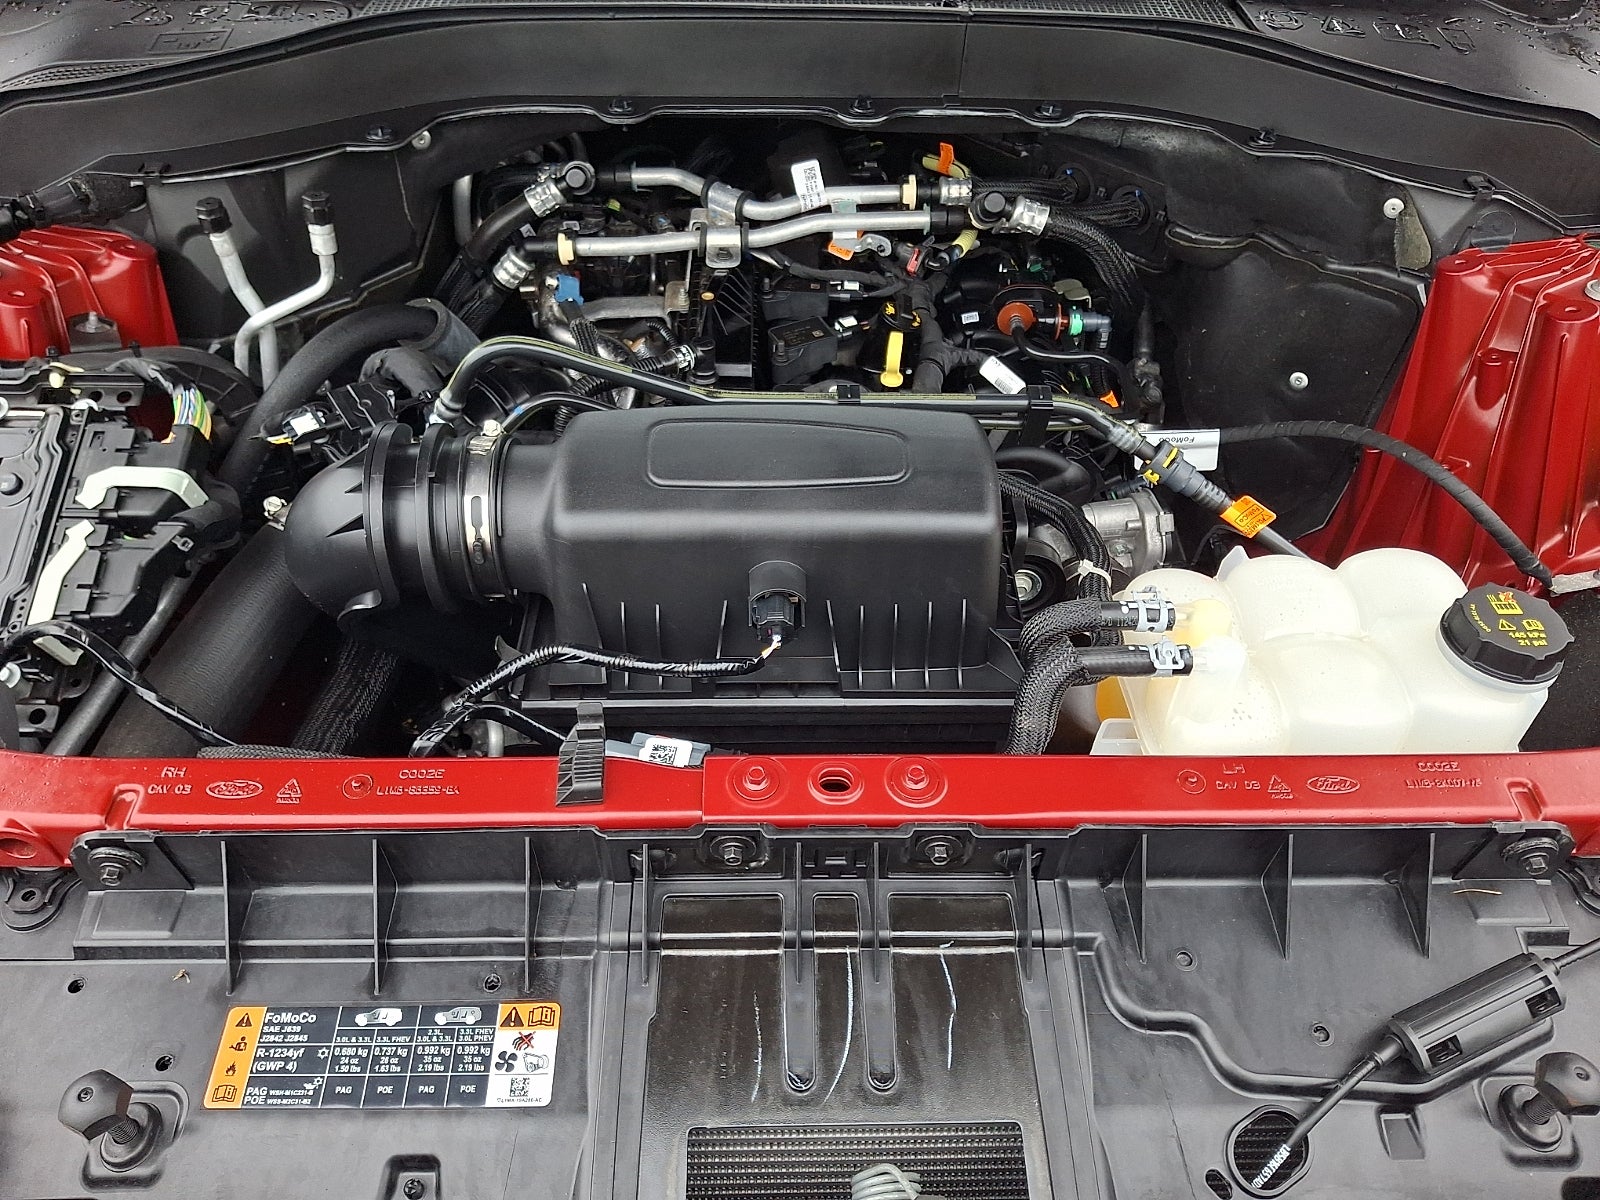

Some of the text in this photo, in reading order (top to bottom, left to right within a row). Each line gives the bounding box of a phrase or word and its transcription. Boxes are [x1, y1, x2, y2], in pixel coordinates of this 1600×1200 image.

[1508, 631, 1547, 640] 145 kPa
[1532, 639, 1548, 647] psi
[161, 766, 186, 778] RH
[1223, 763, 1246, 774] LH
[147, 784, 171, 794] CAV
[264, 1012, 317, 1024] FoMoCo
[391, 1035, 411, 1043] FHEV
[256, 1048, 305, 1060] R-1234yf
[334, 1047, 369, 1058] 0.680 kg
[374, 1047, 408, 1058] 0.737 kg
[417, 1046, 451, 1056] 0.992 kg
[457, 1046, 491, 1056] 0.992 kg
[252, 1061, 297, 1073] (GWP 4)
[418, 1064, 444, 1072] 2.19 lbs
[458, 1064, 485, 1072] 2.19 lbs
[246, 1087, 268, 1096] PAG
[335, 1086, 352, 1094] PAG
[377, 1086, 393, 1094] POE
[418, 1085, 435, 1093] PAG
[460, 1085, 477, 1093] POE
[244, 1096, 266, 1105] POE
